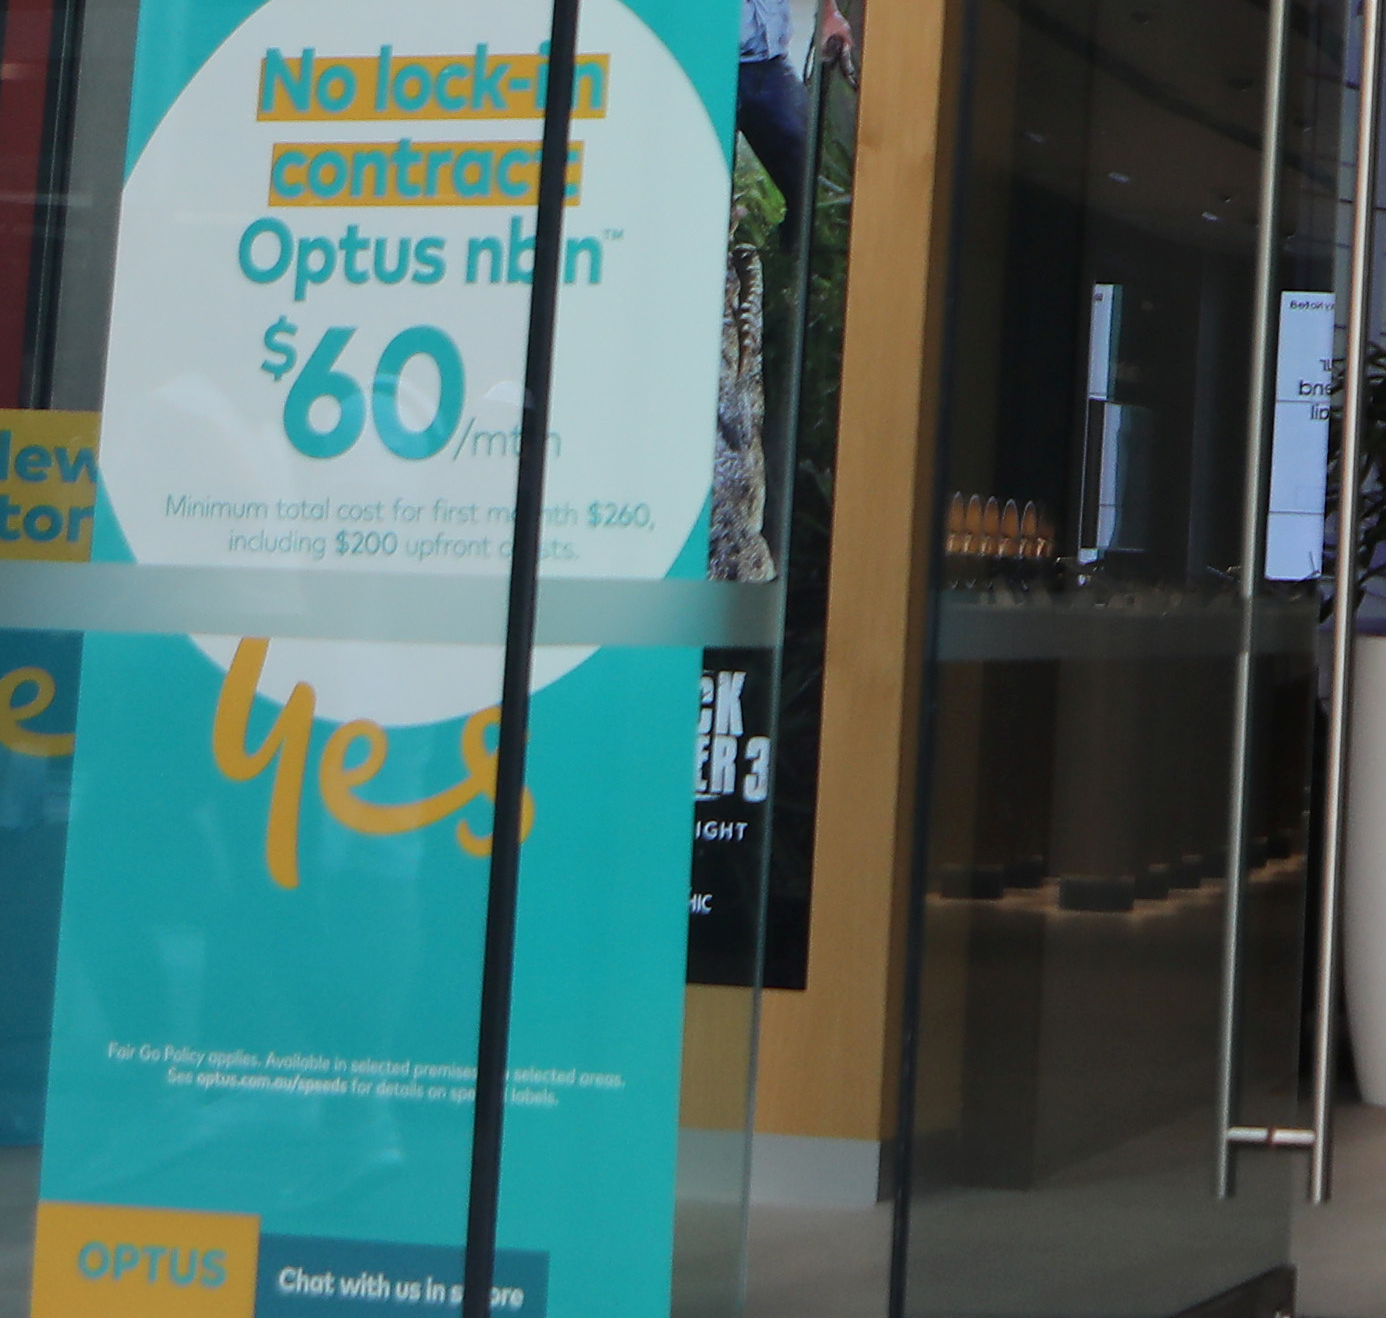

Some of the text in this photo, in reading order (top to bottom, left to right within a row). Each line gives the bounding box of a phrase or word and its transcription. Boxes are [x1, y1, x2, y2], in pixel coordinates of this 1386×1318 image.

[261, 46, 357, 114] No
[239, 216, 447, 302] Optus
[166, 494, 268, 520] Minimum
[276, 498, 330, 520] total
[336, 500, 384, 521] cost
[393, 498, 422, 522] for
[433, 498, 479, 523] first
[588, 500, 654, 531] $260,
[228, 530, 580, 562] including $200 upfront csts.
[212, 637, 535, 890] yes
[742, 736, 771, 803] 3
[108, 1041, 135, 1060] Fair
[139, 1044, 160, 1061] Go
[164, 1044, 205, 1067] Policy
[208, 1050, 261, 1069] applies.
[265, 1051, 330, 1071] Available
[333, 1055, 347, 1071] in
[351, 1058, 410, 1075] selected
[514, 1066, 575, 1084] selected
[167, 1066, 193, 1084] See
[197, 1069, 347, 1094] optus.com.au/speeds
[352, 1079, 372, 1096] for
[376, 1080, 423, 1099] details
[428, 1085, 447, 1100] on
[77, 1241, 228, 1288] OPTUS
[278, 1265, 525, 1308] Chat with us in sore
